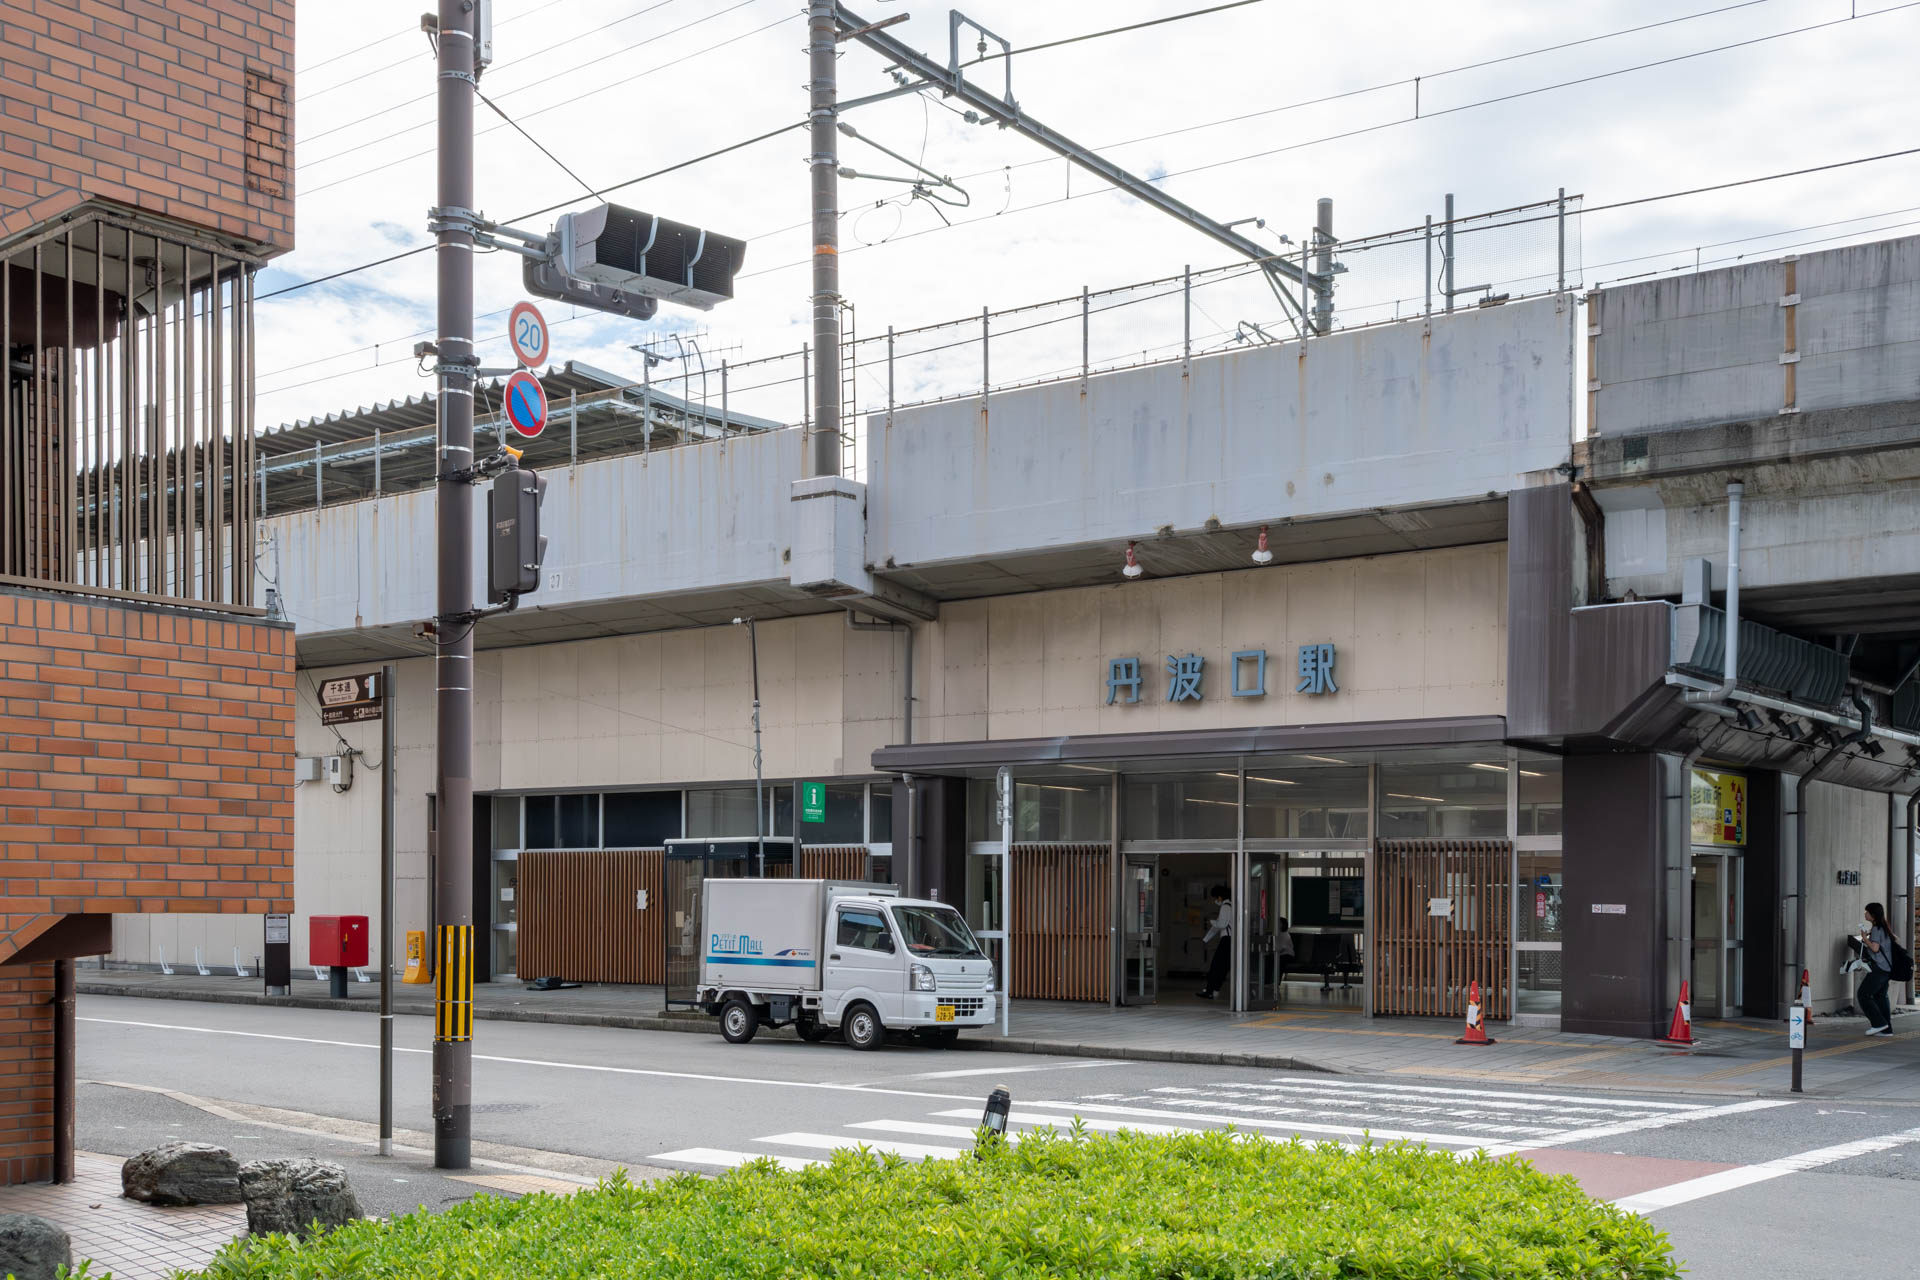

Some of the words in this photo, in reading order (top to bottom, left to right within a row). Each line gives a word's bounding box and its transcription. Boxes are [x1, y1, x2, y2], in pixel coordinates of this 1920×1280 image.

[518, 318, 540, 351] 20
[330, 681, 351, 694] 千本通
[1106, 643, 1339, 705] 丹波口駅
[712, 933, 737, 953] PETIT
[739, 935, 763, 954] MALL
